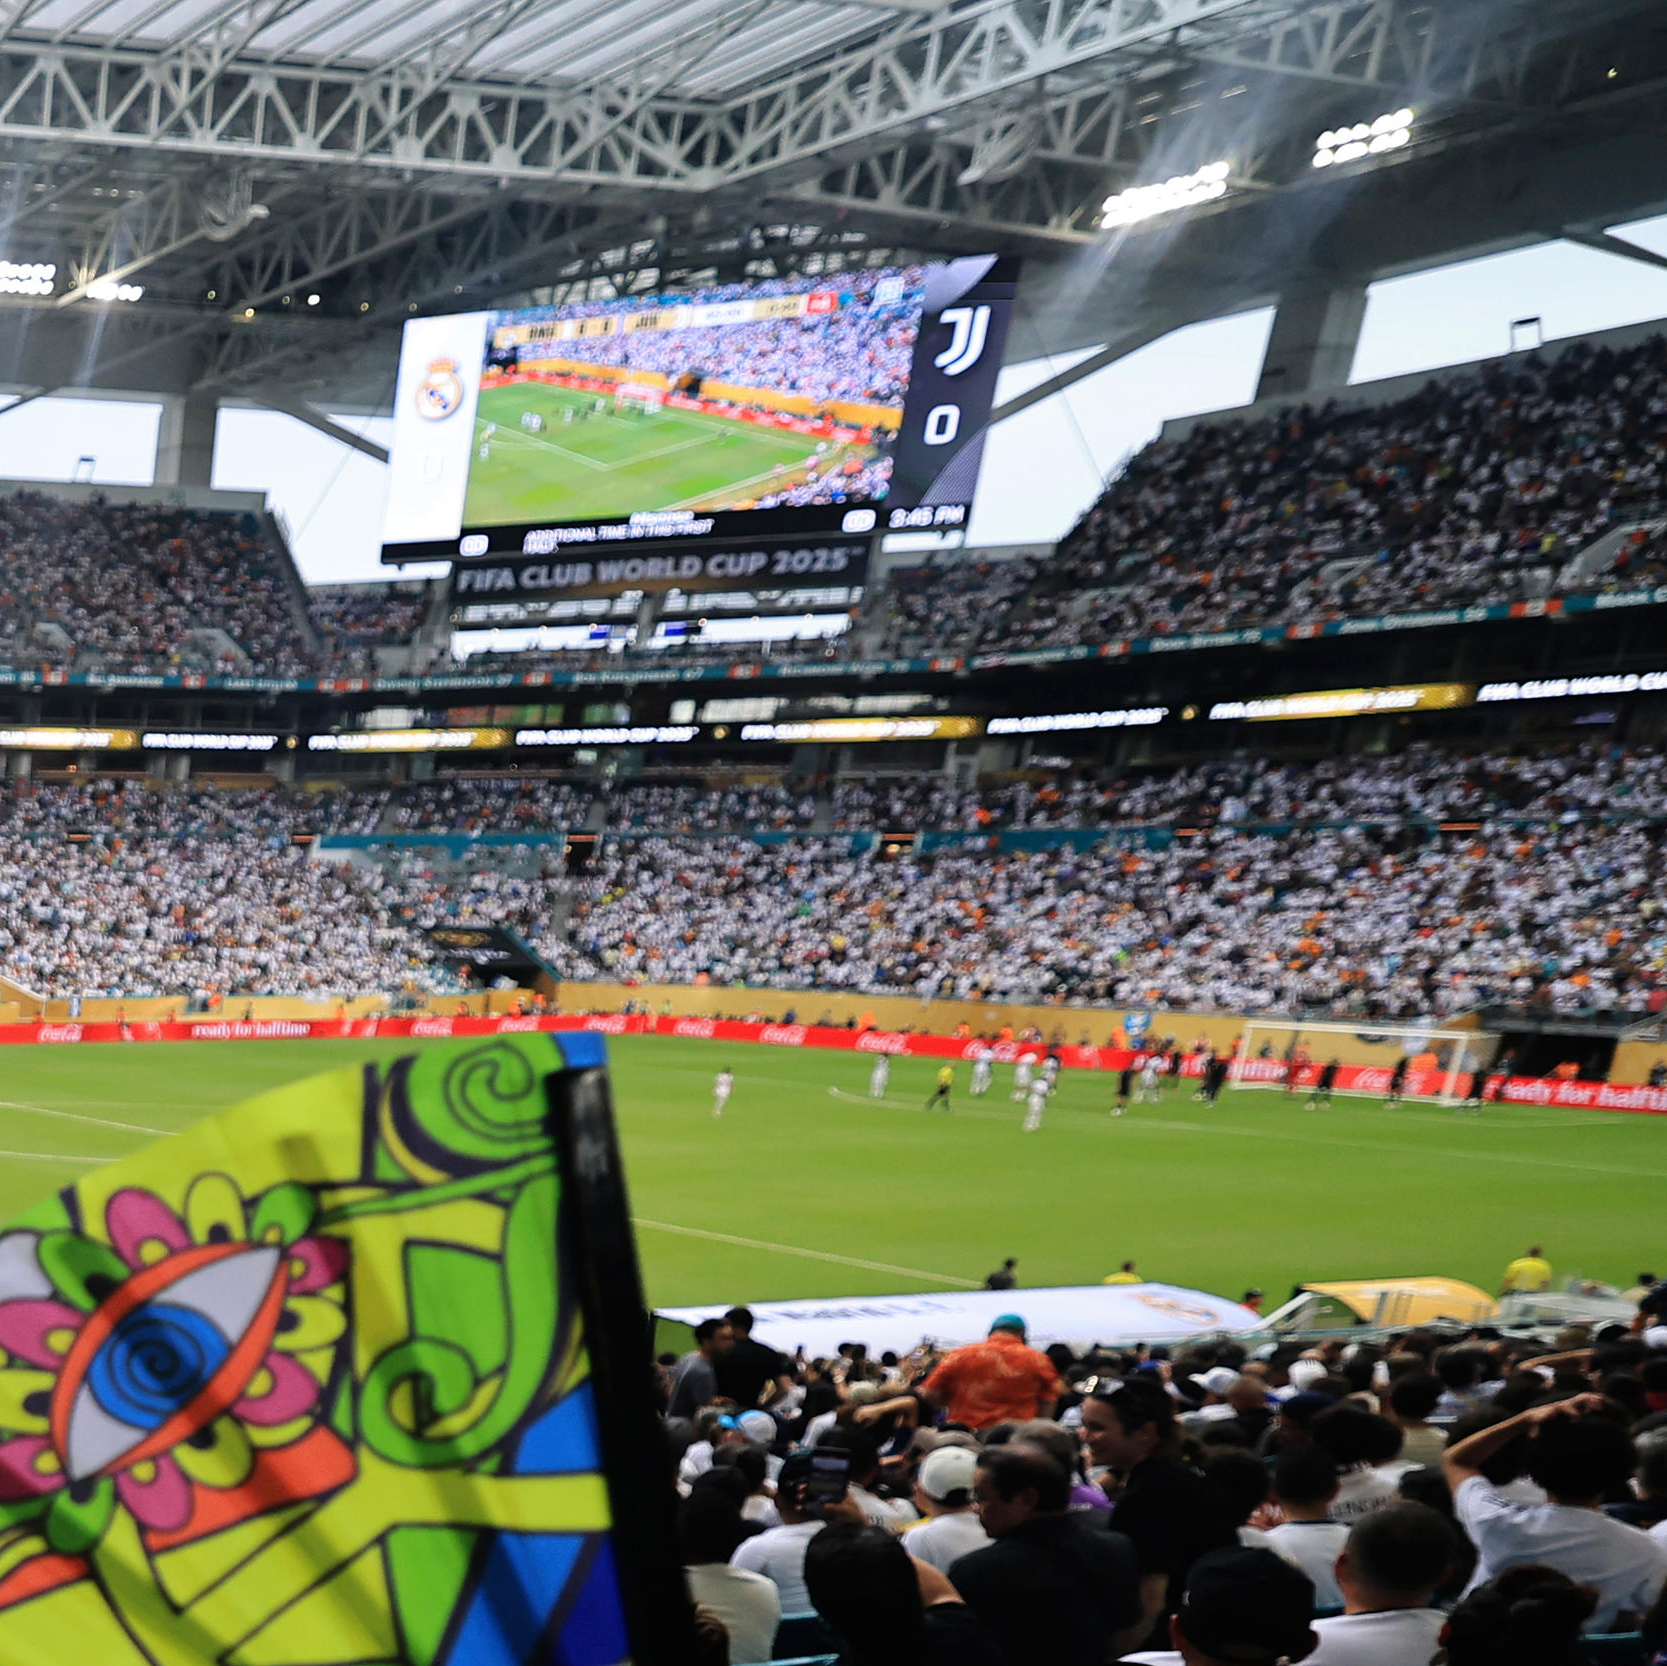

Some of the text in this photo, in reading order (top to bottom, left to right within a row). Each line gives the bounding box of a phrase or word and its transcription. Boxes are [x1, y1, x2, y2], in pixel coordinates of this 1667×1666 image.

[923, 403, 961, 446] 0
[457, 566, 517, 593] FIFA
[519, 562, 594, 589] CLUB
[596, 555, 704, 584] WORLD
[704, 552, 769, 579] CUP
[190, 1020, 312, 1041] ready for halftime
